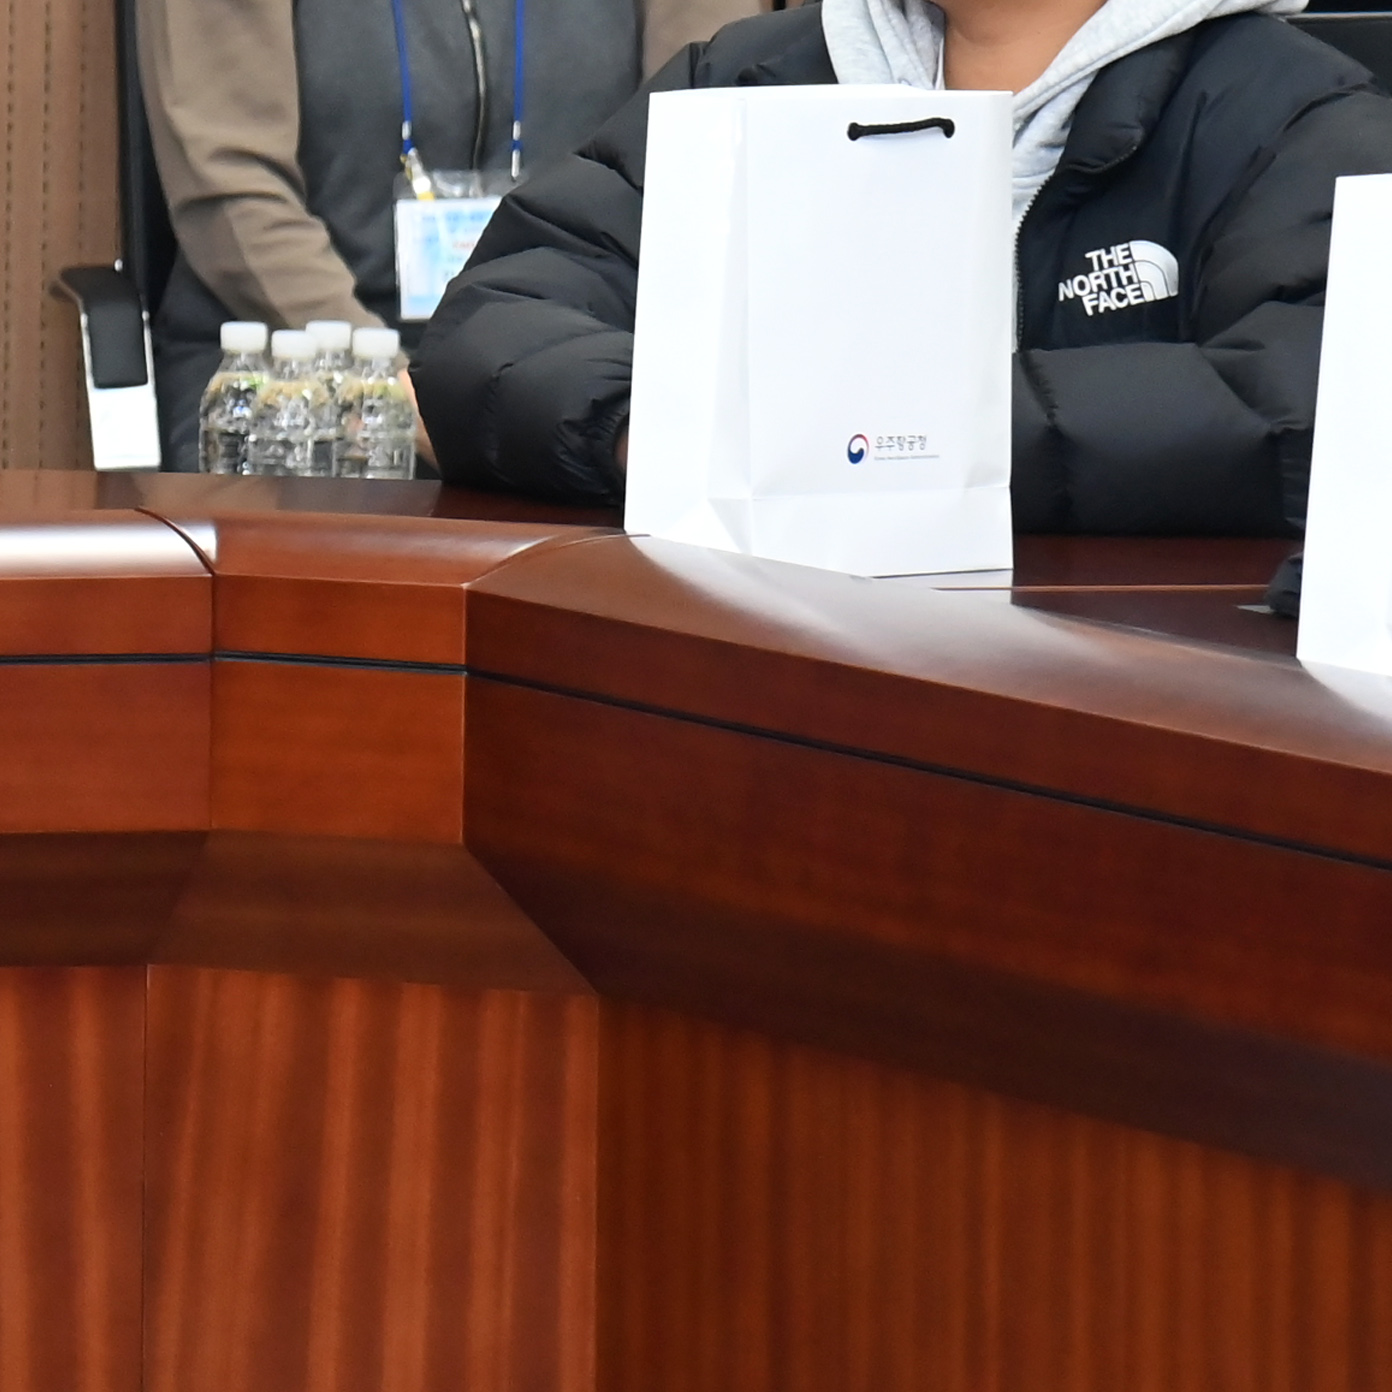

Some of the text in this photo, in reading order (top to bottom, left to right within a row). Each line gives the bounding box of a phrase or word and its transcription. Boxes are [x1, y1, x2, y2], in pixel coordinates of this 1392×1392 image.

[1084, 242, 1134, 272] THE
[1058, 263, 1138, 302] NORTH
[1082, 284, 1146, 317] FACE
